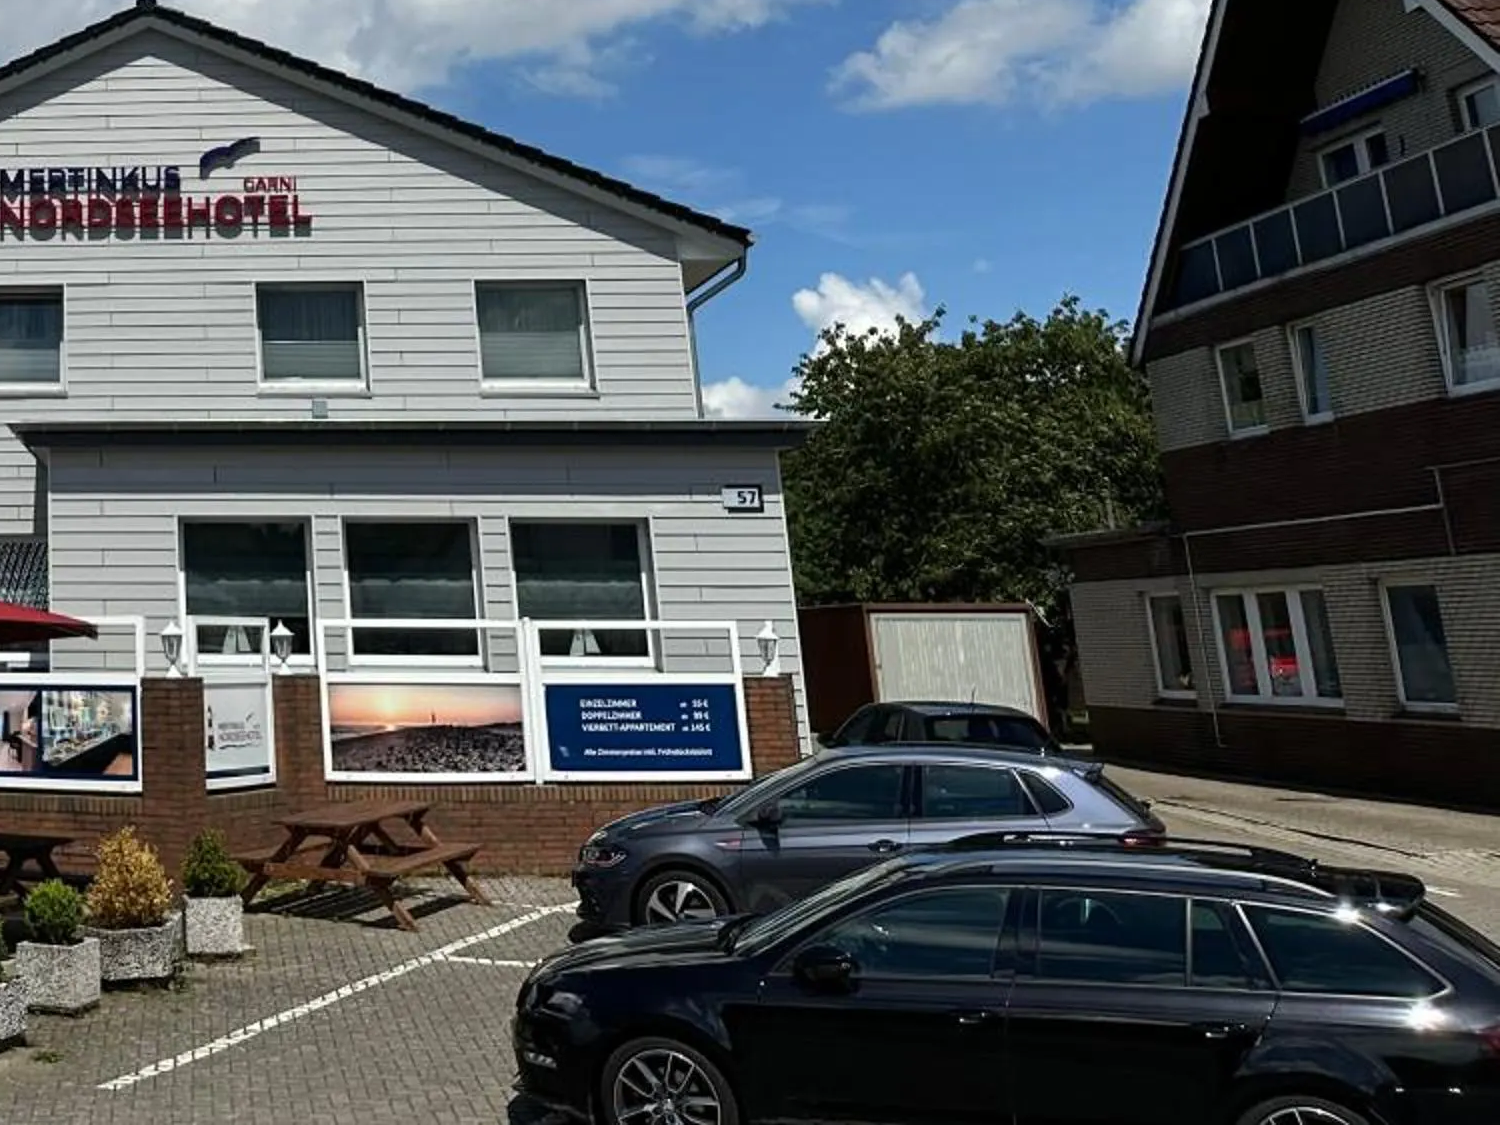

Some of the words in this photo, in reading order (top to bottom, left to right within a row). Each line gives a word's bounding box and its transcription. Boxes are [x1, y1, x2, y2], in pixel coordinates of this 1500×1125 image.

[0, 165, 181, 195] MERTINKUS
[243, 176, 298, 193] GARNI
[0, 194, 313, 236] NORDSEEHOTEL
[737, 490, 757, 505] 57
[579, 698, 637, 708] EINZELZIMMER
[581, 710, 643, 720] DOPPELZIMMER
[582, 722, 676, 732] VIERBETT-APPARTEMENT
